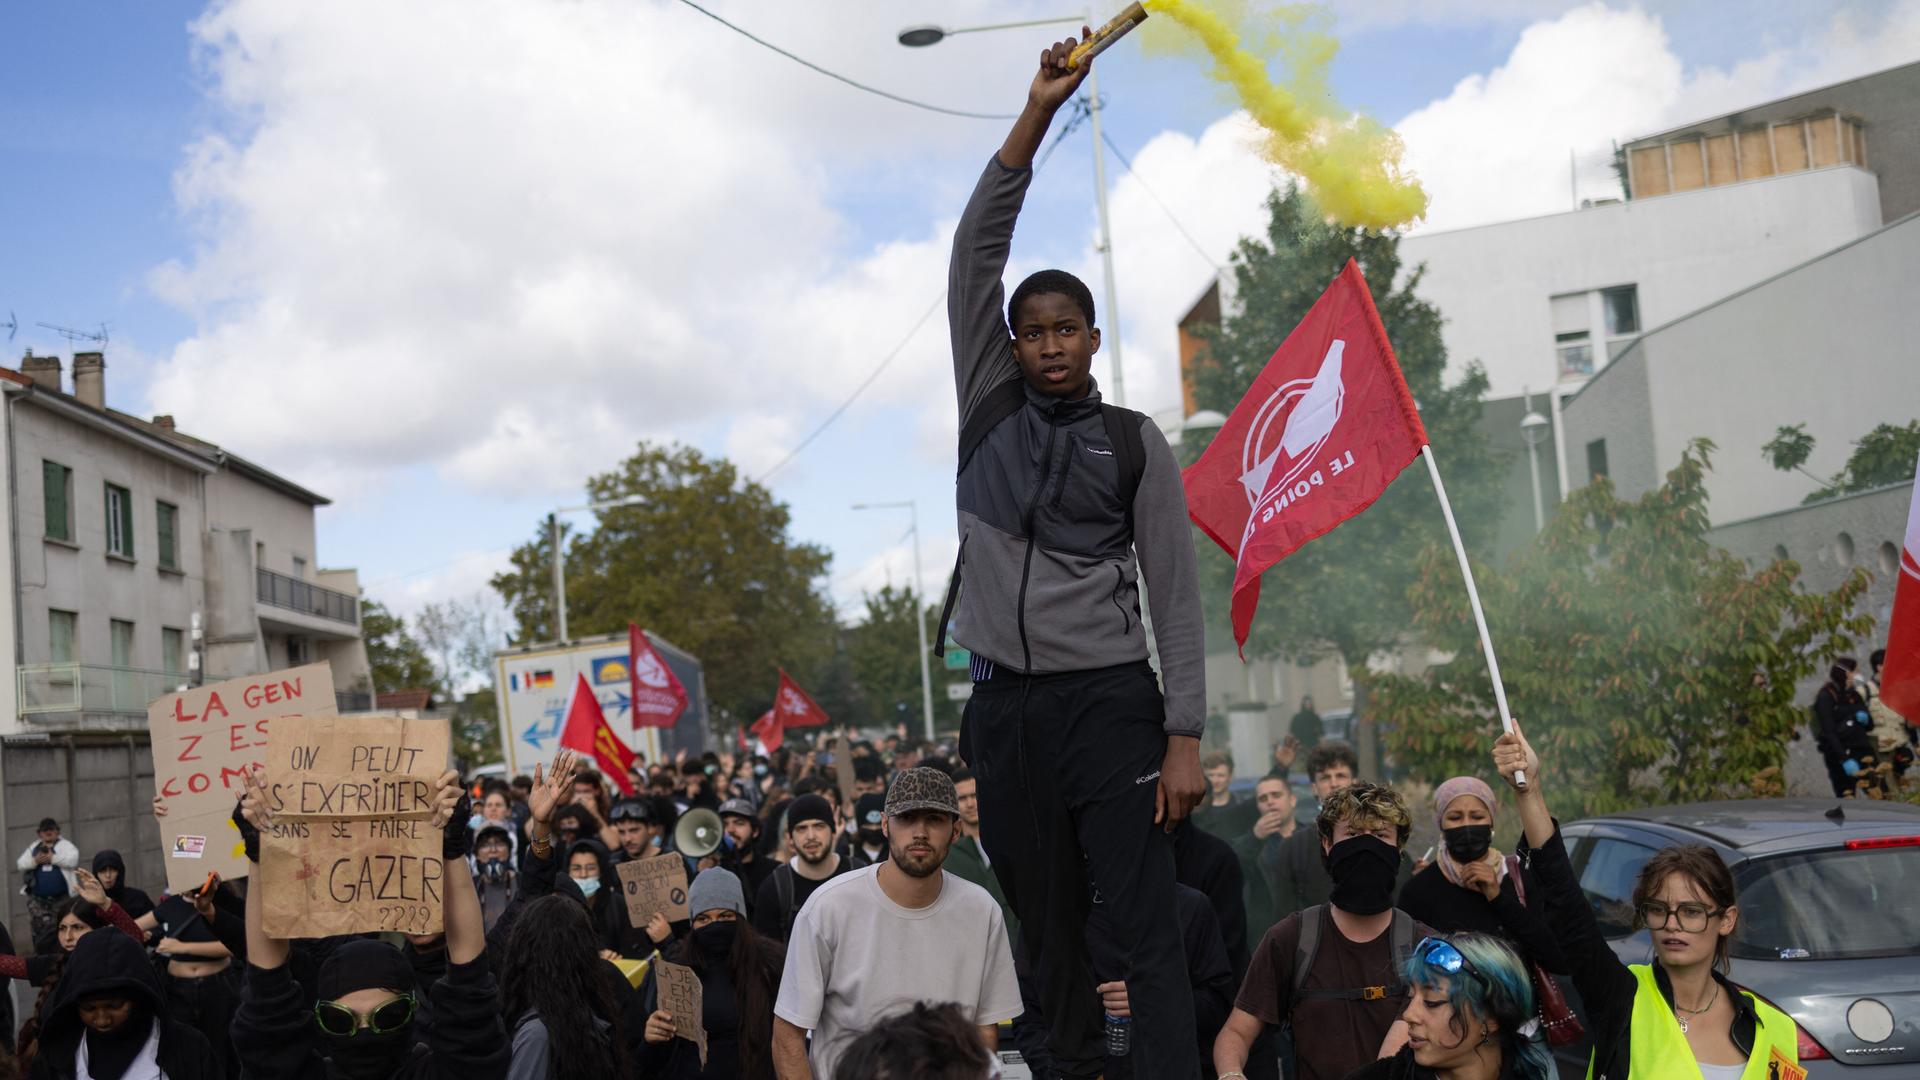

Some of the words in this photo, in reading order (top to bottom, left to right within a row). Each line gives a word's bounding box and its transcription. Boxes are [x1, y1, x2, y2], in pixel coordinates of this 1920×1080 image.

[174, 692, 229, 722] LA
[243, 677, 302, 708] GEN
[177, 735, 202, 762] Z
[291, 746, 320, 770] ON
[351, 746, 424, 774] PEUT
[161, 762, 265, 797] COM
[1140, 770, 1161, 783] Columb
[273, 822, 310, 839] SANS
[331, 820, 352, 839] SE
[329, 856, 442, 904] GAZER
[379, 906, 431, 934] ????
[657, 966, 673, 980] LA
[677, 969, 692, 984] JE
[671, 984, 693, 1000] EM
